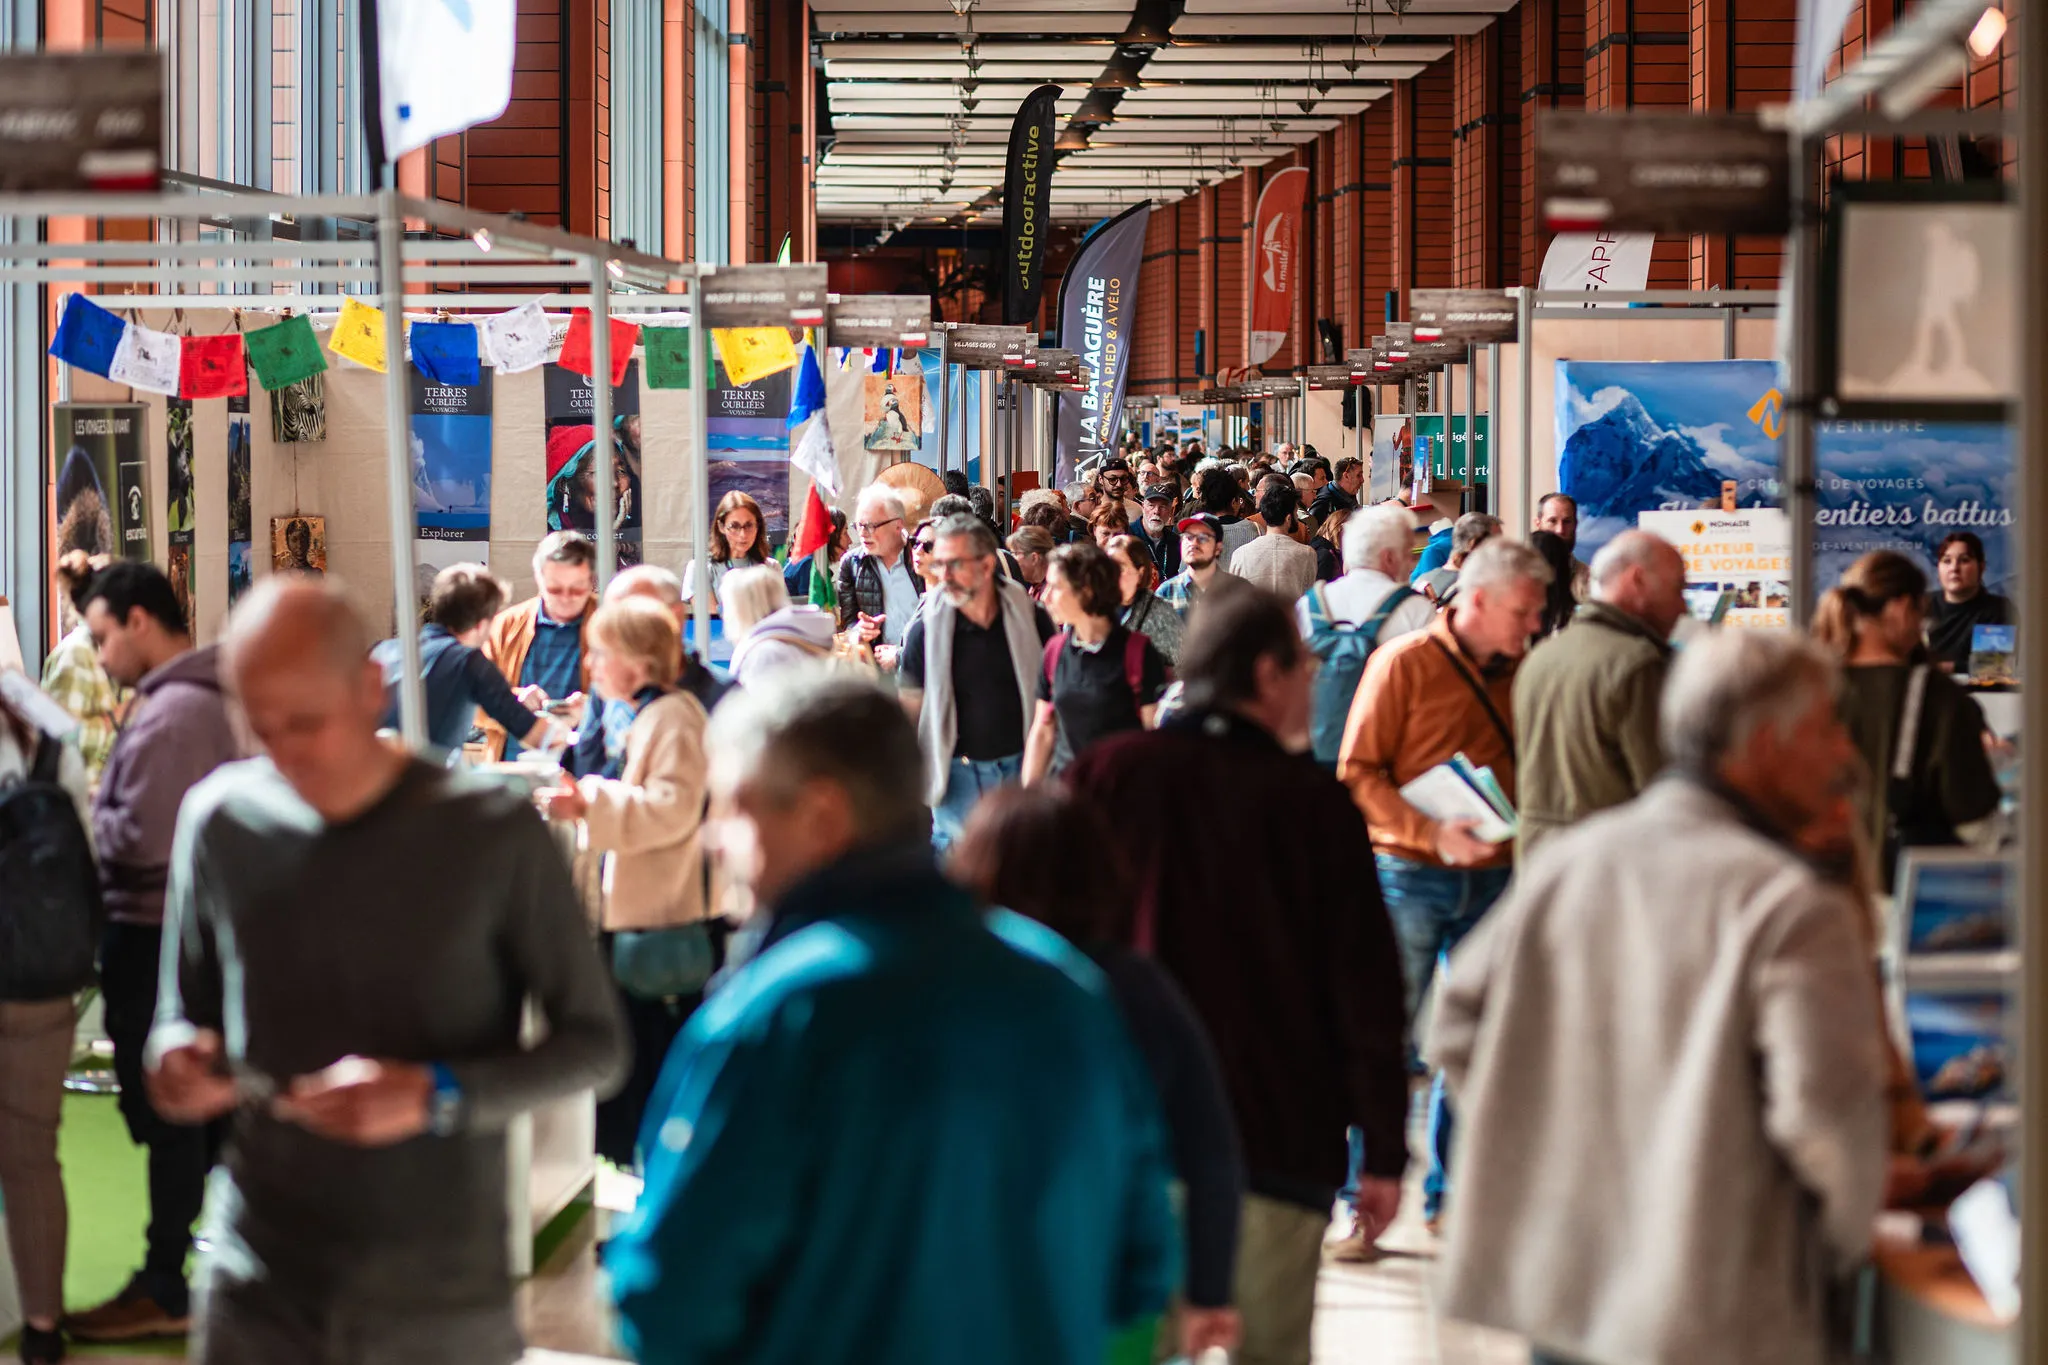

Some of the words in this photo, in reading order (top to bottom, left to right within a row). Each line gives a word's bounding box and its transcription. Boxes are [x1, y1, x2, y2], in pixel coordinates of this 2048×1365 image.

[1017, 125, 1040, 290] outdooractive
[1279, 251, 1288, 281] malle
[1107, 278, 1121, 313] VÉLO
[1106, 329, 1118, 340] &
[1104, 343, 1117, 375] PIED
[424, 387, 467, 397] TERRES
[722, 389, 765, 400] TERRES
[424, 396, 467, 406] OUBLIÉES
[721, 399, 765, 409] OUBLIÉES
[1101, 391, 1114, 444] VOYAGES
[1079, 420, 1097, 444] LA
[1819, 420, 1926, 433] VENTURE
[1831, 478, 1850, 490] DE
[1857, 478, 1925, 490] VOYAGES
[1814, 500, 1917, 526] entiers
[1923, 500, 2016, 527] battus
[421, 528, 465, 540] Explorer
[1750, 614, 1787, 628] DES
